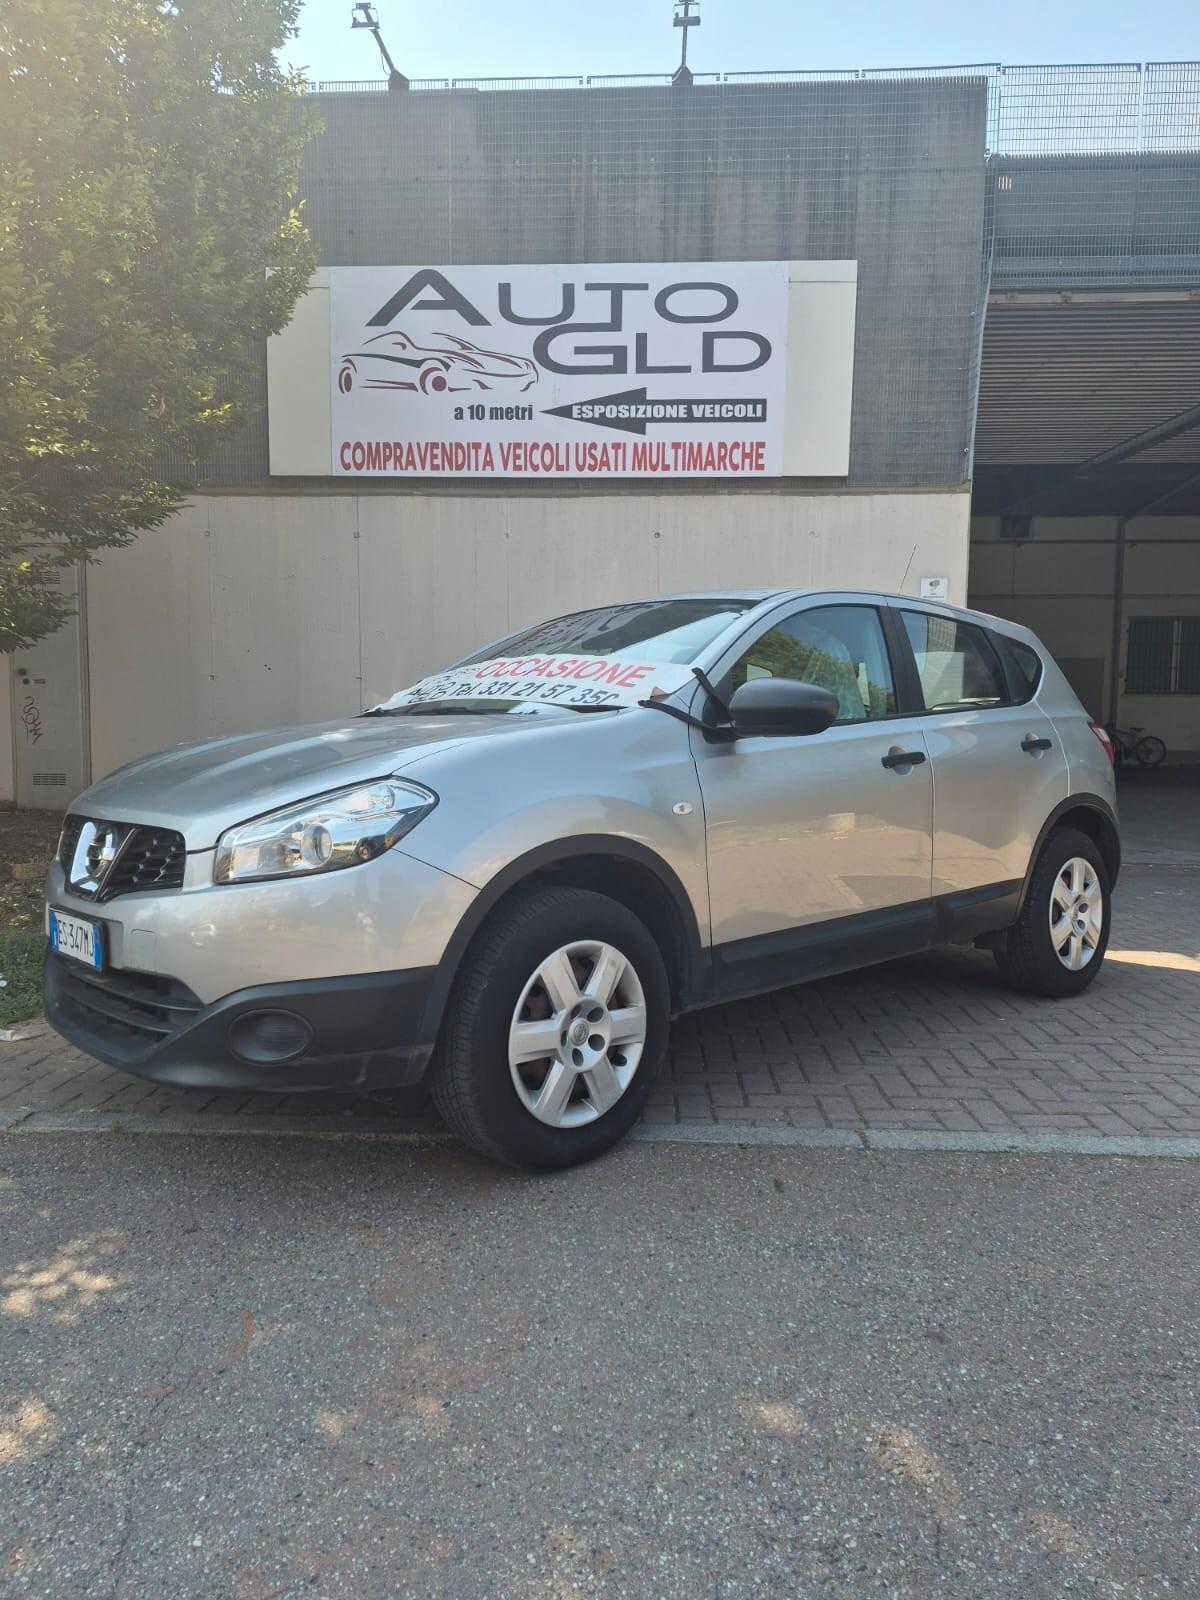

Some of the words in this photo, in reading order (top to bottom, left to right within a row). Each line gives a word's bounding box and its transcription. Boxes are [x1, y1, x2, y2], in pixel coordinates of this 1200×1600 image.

[365, 268, 739, 331] AUTO
[532, 323, 772, 375] GLD
[454, 406, 464, 421] a
[467, 404, 486, 421] 10
[489, 404, 534, 421] metri
[572, 404, 688, 419] ESPOSIZIONE
[691, 403, 763, 418] VEICOLI
[340, 441, 496, 472] COMPRAVENDITA
[498, 441, 571, 472] VEICOLI
[574, 441, 627, 472] USATI
[631, 441, 767, 472] MULTIMARCHE
[475, 657, 657, 688] OCCASIONE
[478, 681, 520, 696] 331
[512, 681, 546, 697] 21
[541, 683, 577, 699] 57
